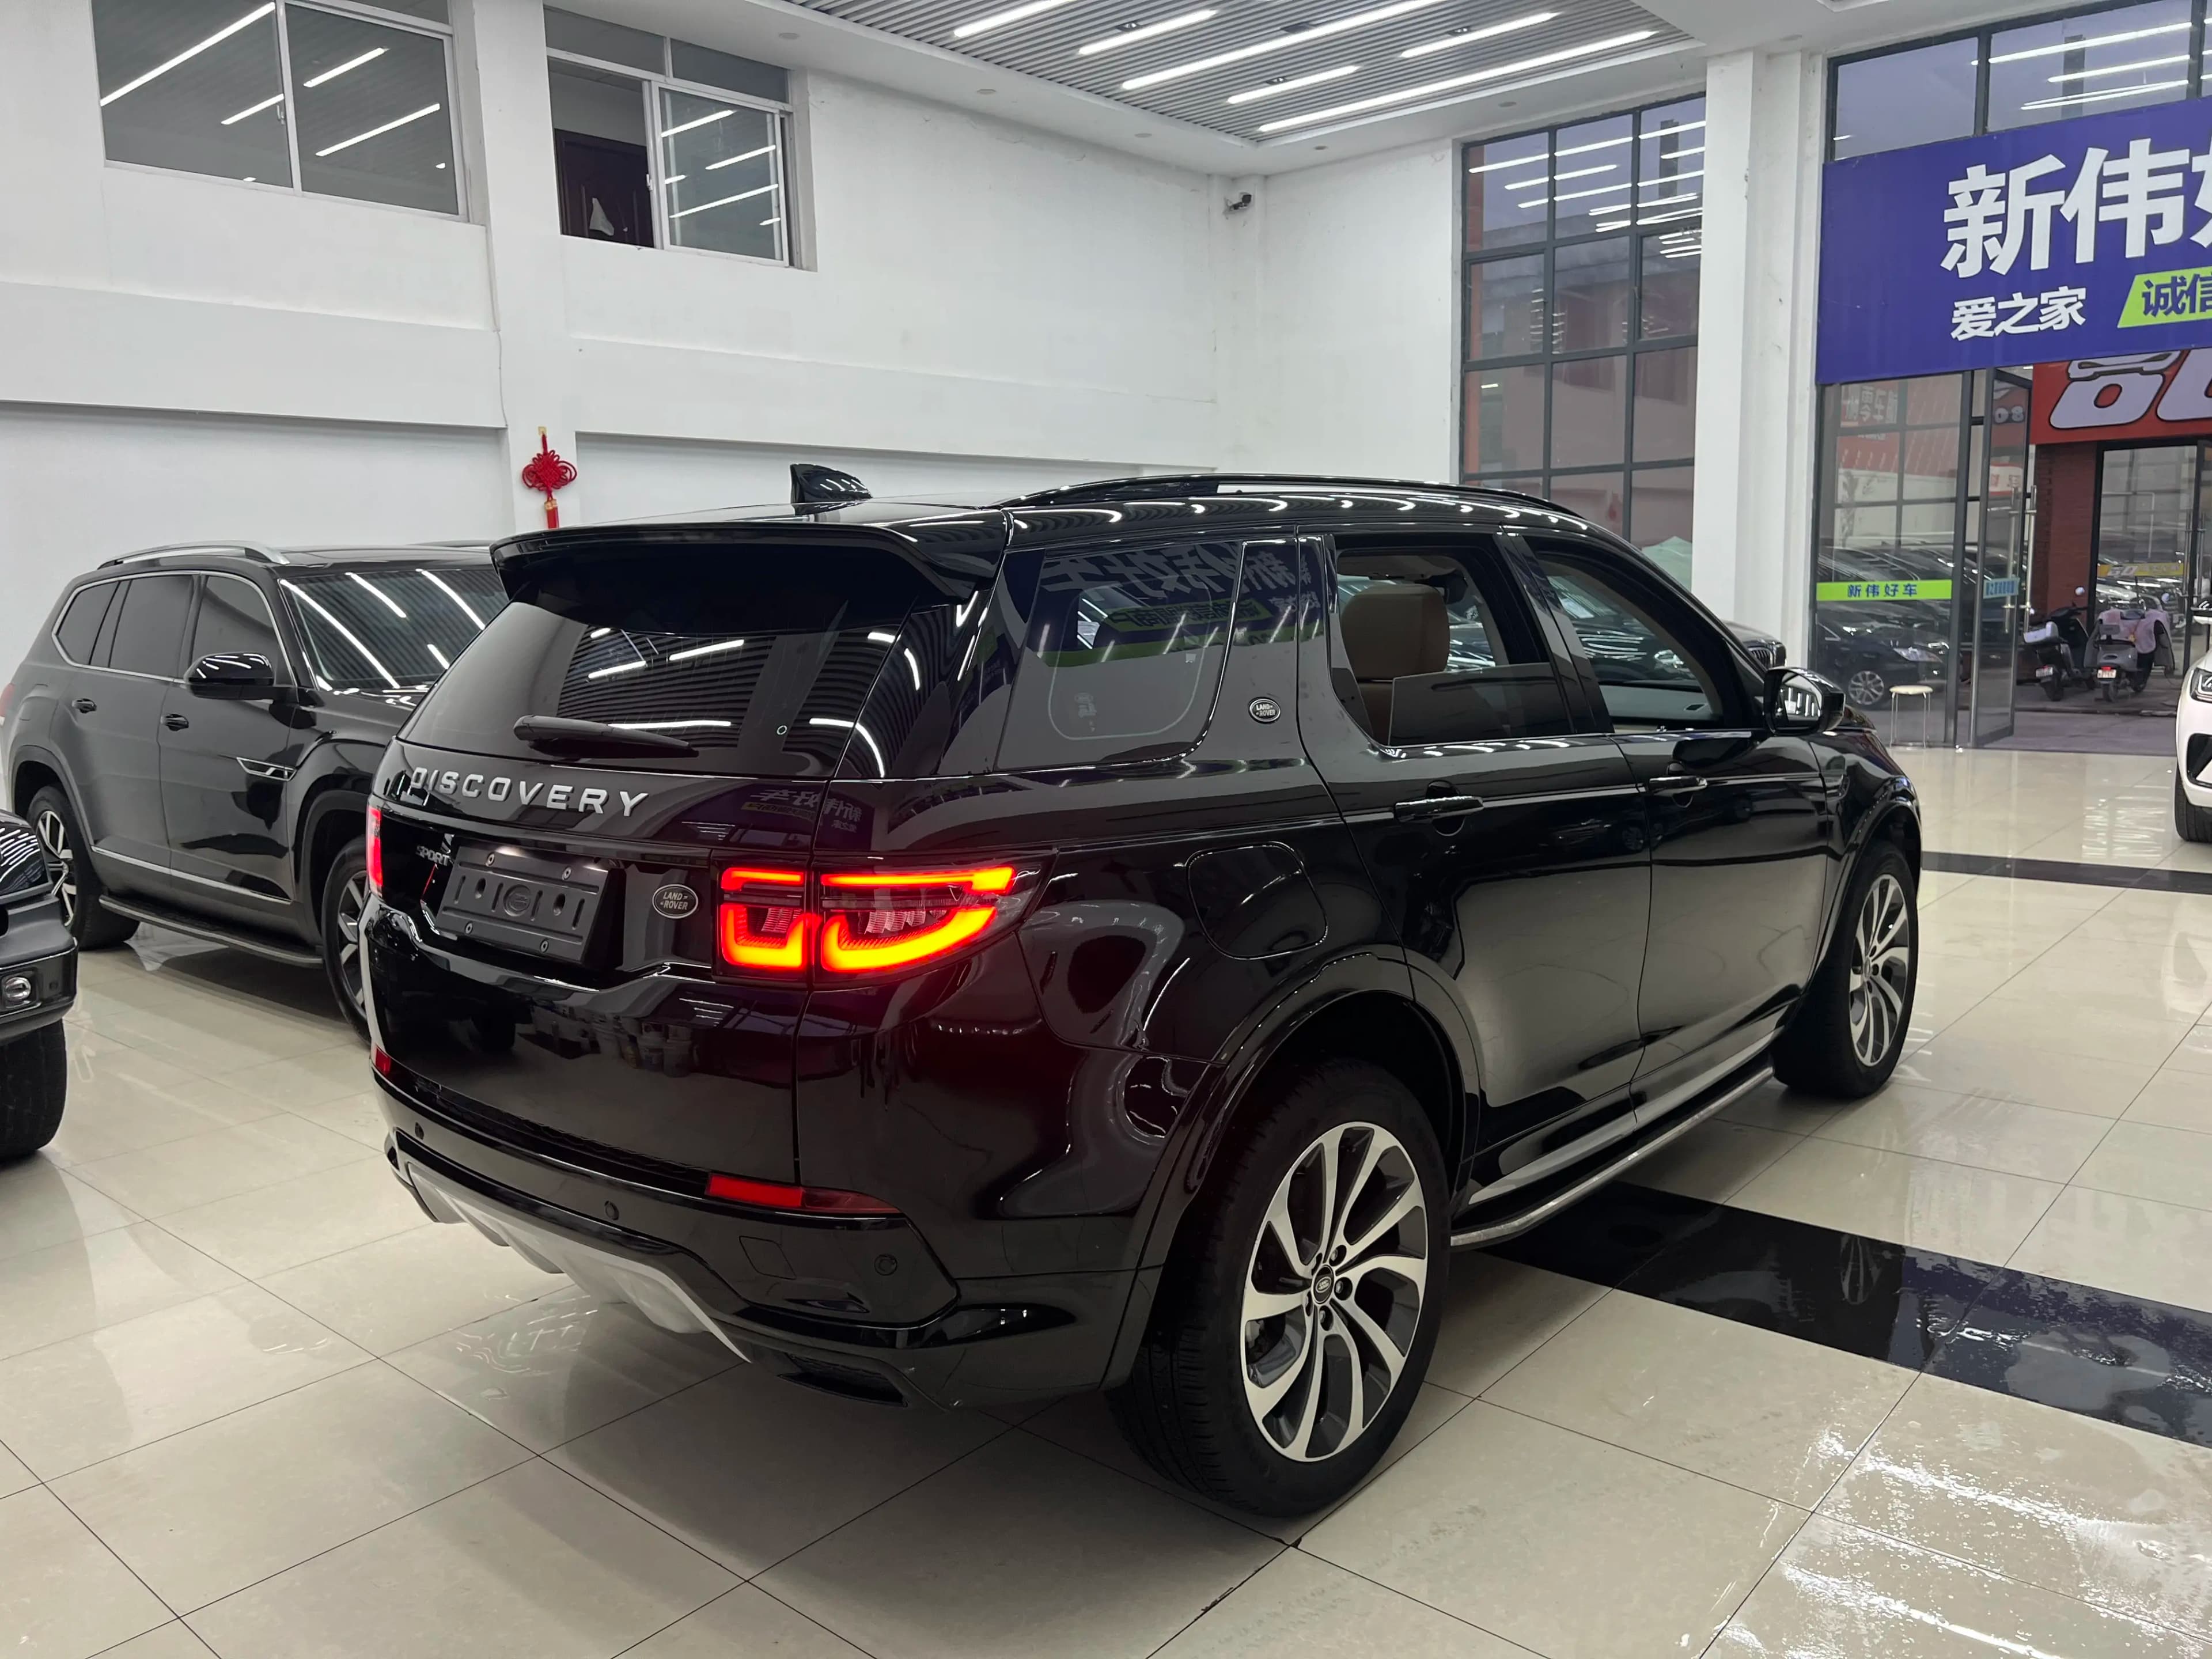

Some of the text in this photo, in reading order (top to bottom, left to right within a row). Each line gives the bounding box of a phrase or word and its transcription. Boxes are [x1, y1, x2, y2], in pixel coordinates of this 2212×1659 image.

[1940, 136, 2212, 278] 新伟
[1950, 286, 2086, 341] 爱之家
[1847, 584, 1918, 598] 新伟好车
[410, 767, 649, 817] DISCOVERY
[415, 845, 450, 866] SPORT
[663, 891, 683, 900] LAND
[663, 900, 688, 910] ROVER
